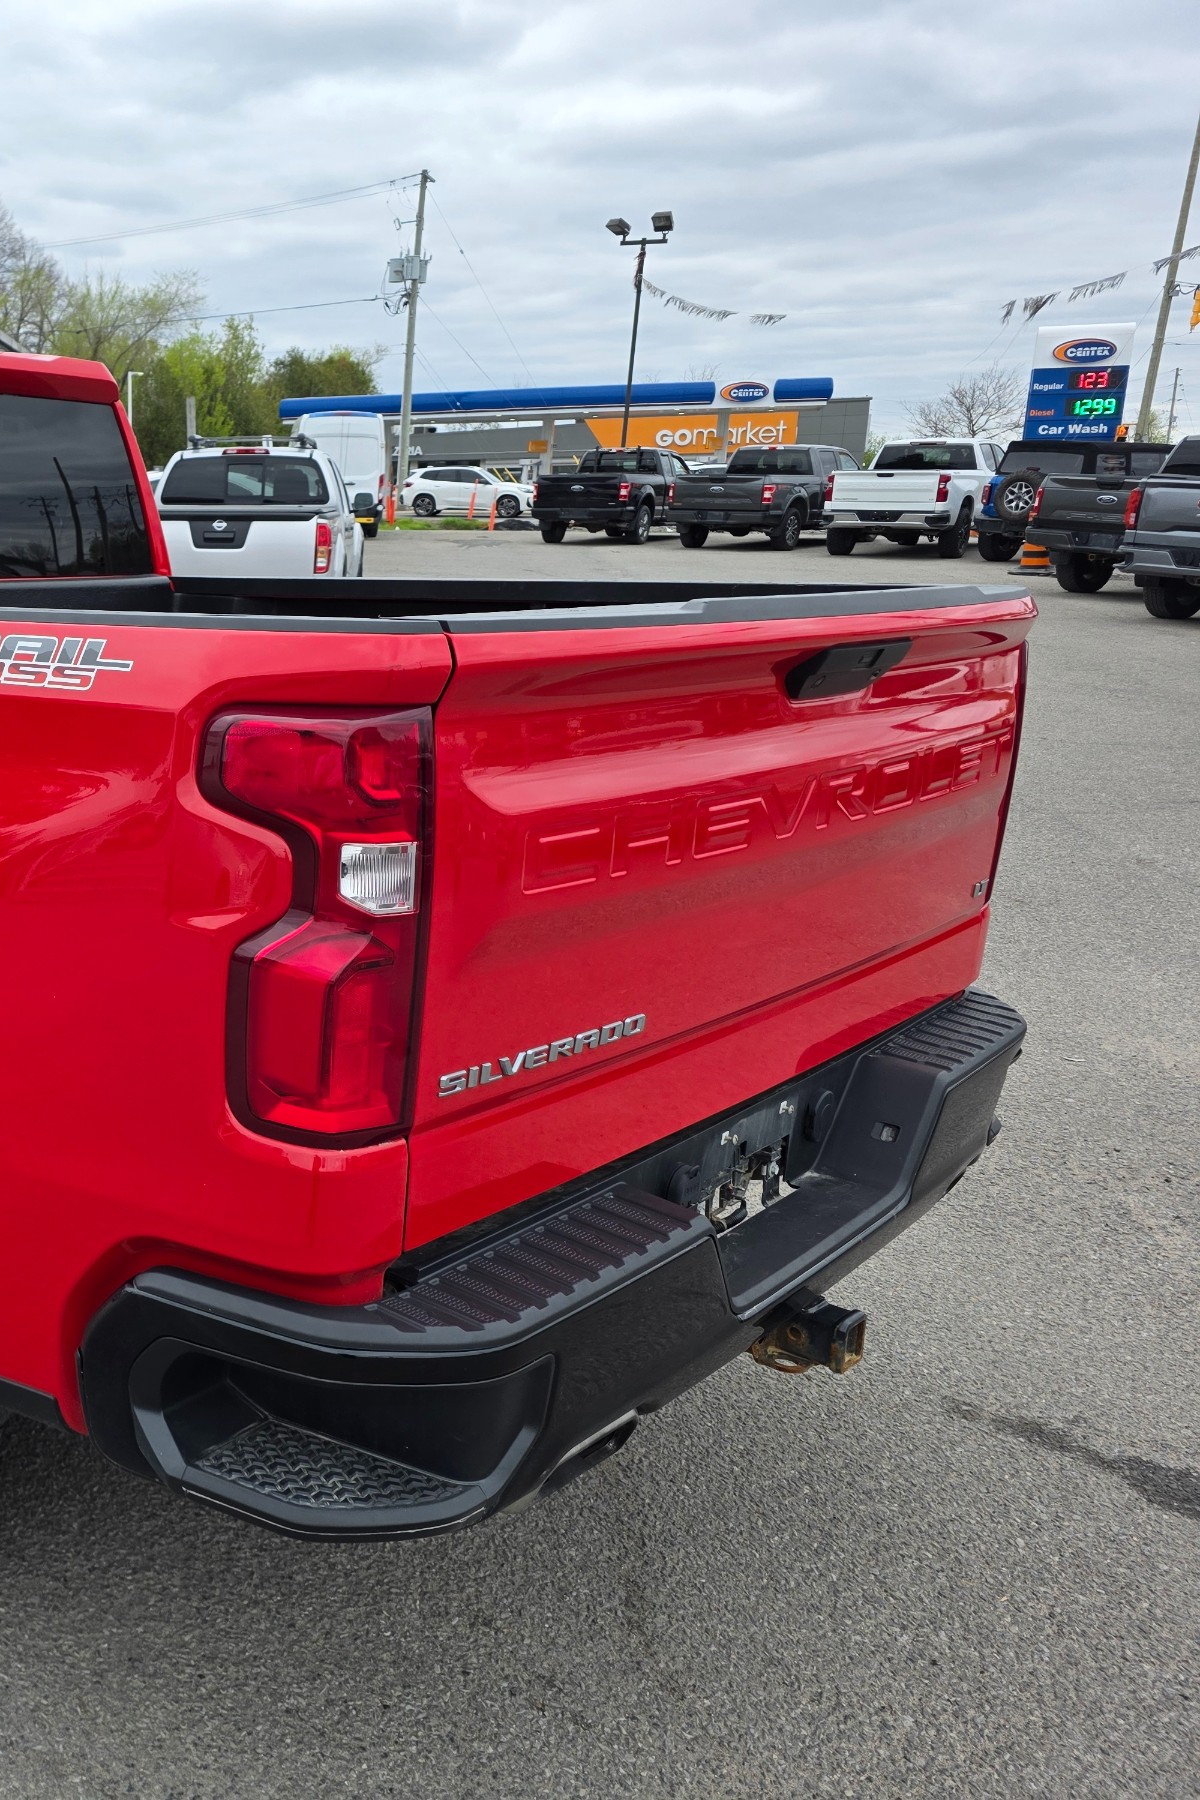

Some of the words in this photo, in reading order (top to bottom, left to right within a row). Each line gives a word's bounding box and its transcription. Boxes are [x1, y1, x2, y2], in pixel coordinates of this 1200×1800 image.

[1033, 383, 1064, 391] Regular
[1073, 398, 1116, 415] 1299
[1038, 424, 1064, 435] Car
[1068, 424, 1108, 434] Wash
[521, 727, 1013, 895] CHEVROLET
[438, 1013, 646, 1098] SILVERADO
